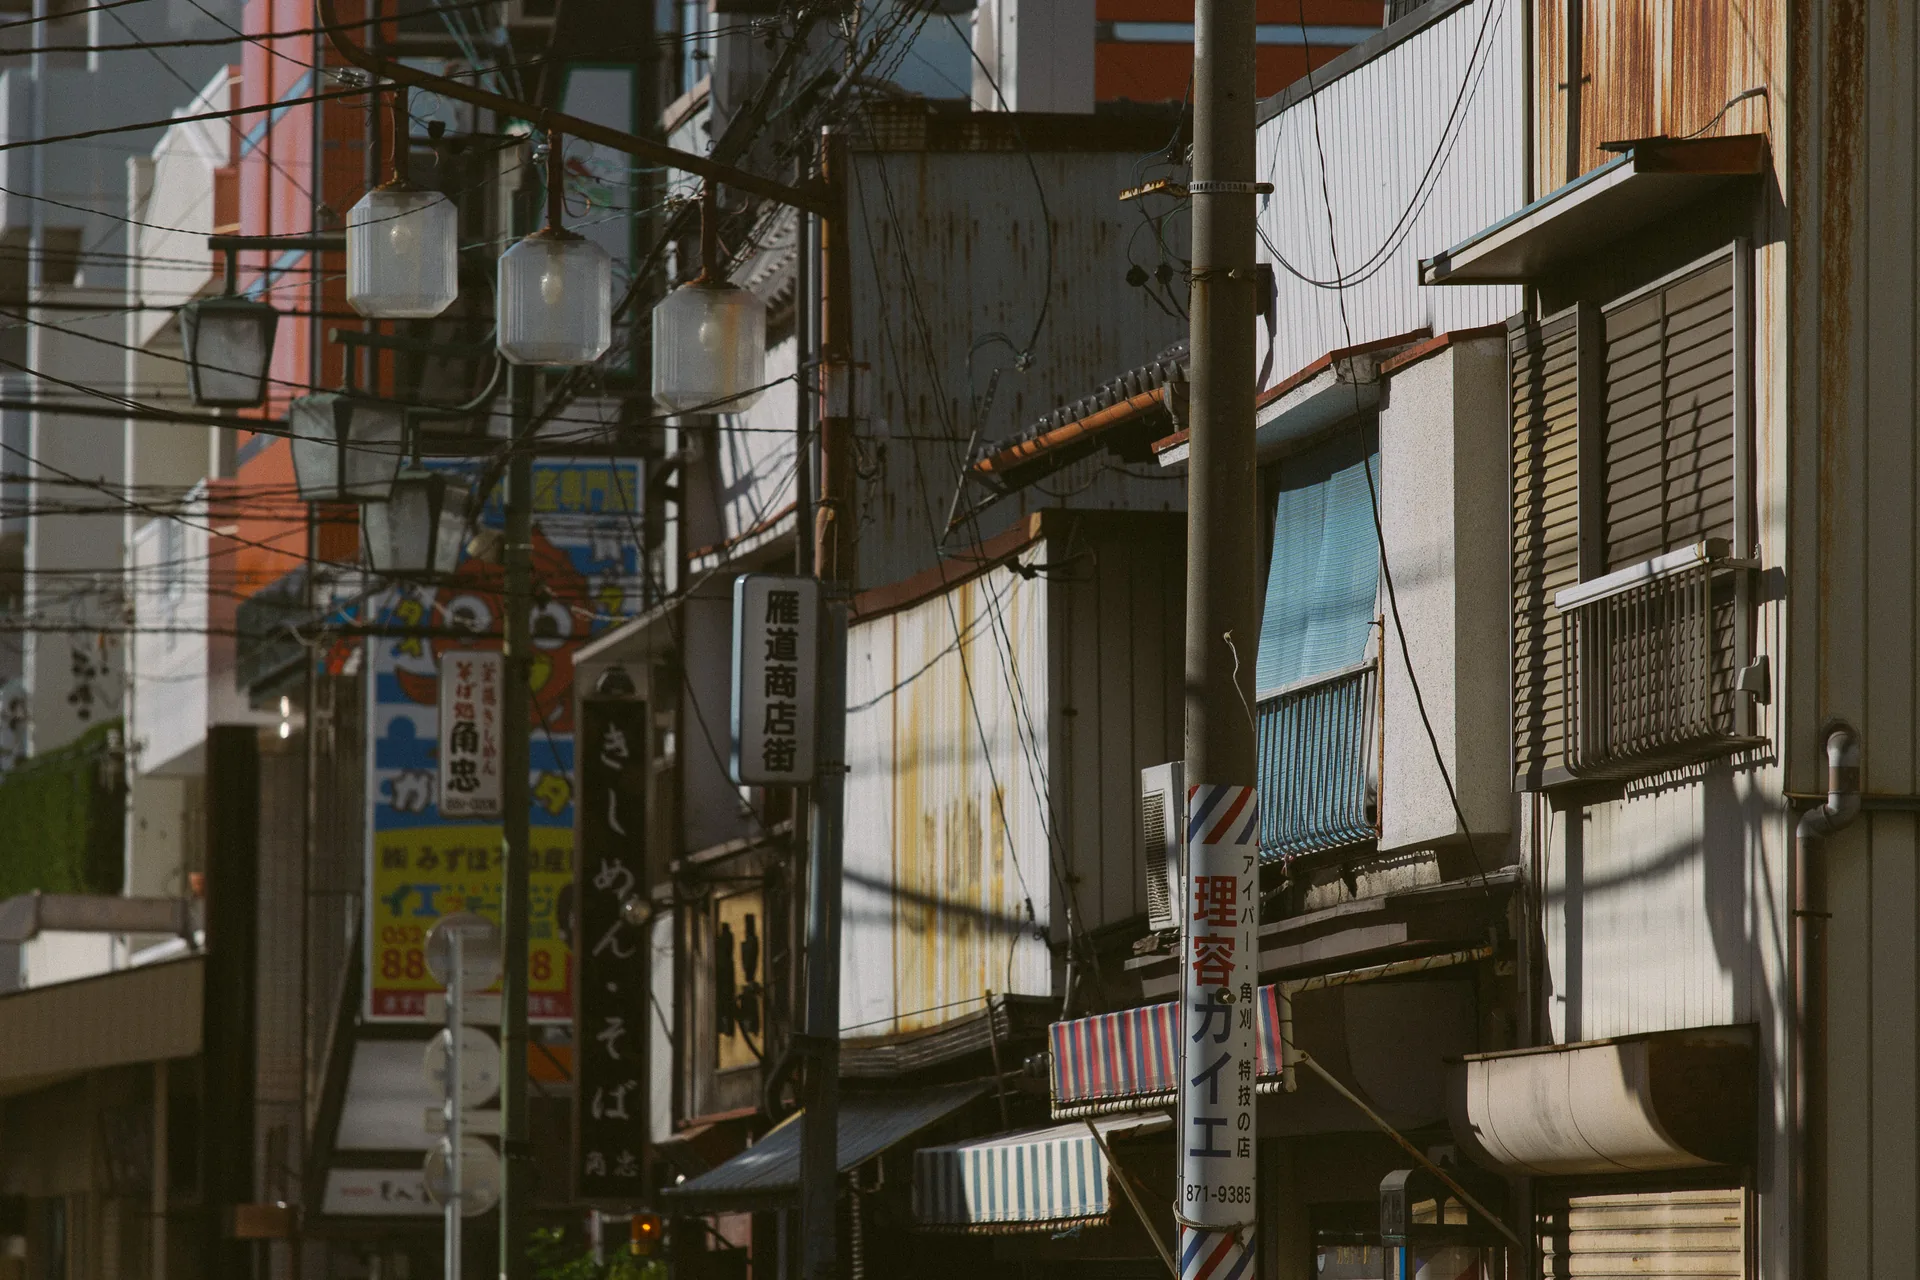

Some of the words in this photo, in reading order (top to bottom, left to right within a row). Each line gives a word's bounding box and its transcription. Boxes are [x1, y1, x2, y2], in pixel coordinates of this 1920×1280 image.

[763, 590, 798, 772] 雁道商店街
[1237, 854, 1257, 1159] アイパー・角刈・特技の店
[1186, 1184, 1252, 1205] 871-9385
